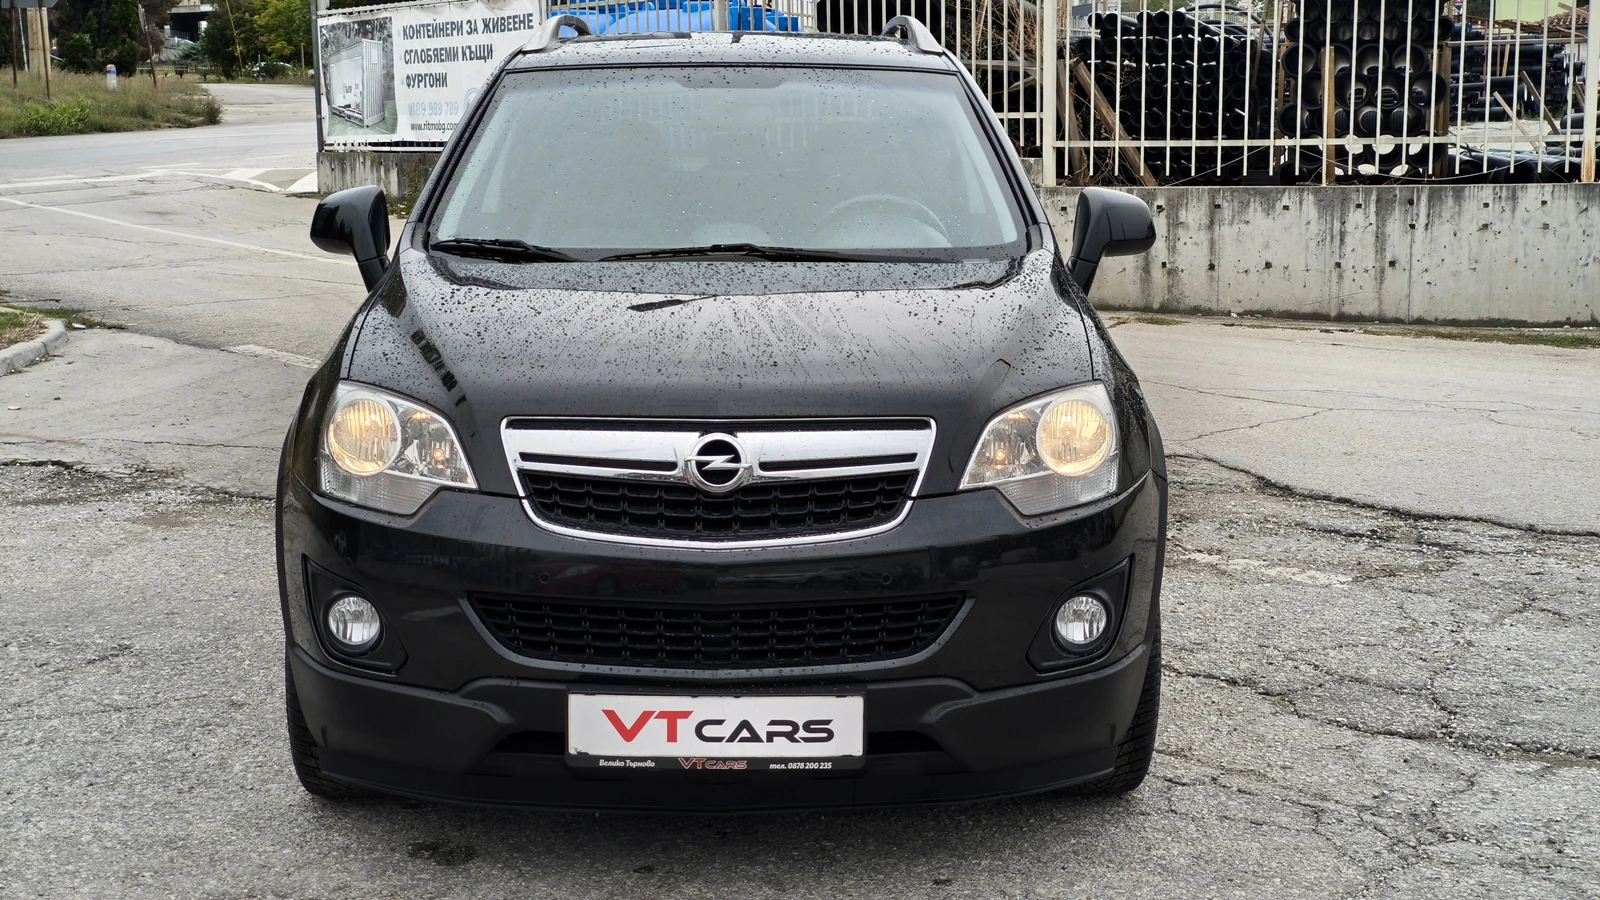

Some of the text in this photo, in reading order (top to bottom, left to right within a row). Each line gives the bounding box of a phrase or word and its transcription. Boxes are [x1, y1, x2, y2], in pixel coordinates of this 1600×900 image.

[402, 13, 534, 40] КОНТЕЙНЕРИ ЗА ЖИВЕЕНЕ
[403, 43, 493, 65] СГЛОБЯЕМИ КЪЩИ
[405, 72, 448, 89] ФУРГОНИ
[428, 101, 442, 116] 989
[444, 101, 459, 115] 789
[599, 759, 655, 768] Велико Търново
[787, 762, 804, 770] 0878
[805, 762, 818, 770] 200
[820, 762, 832, 770] 235
